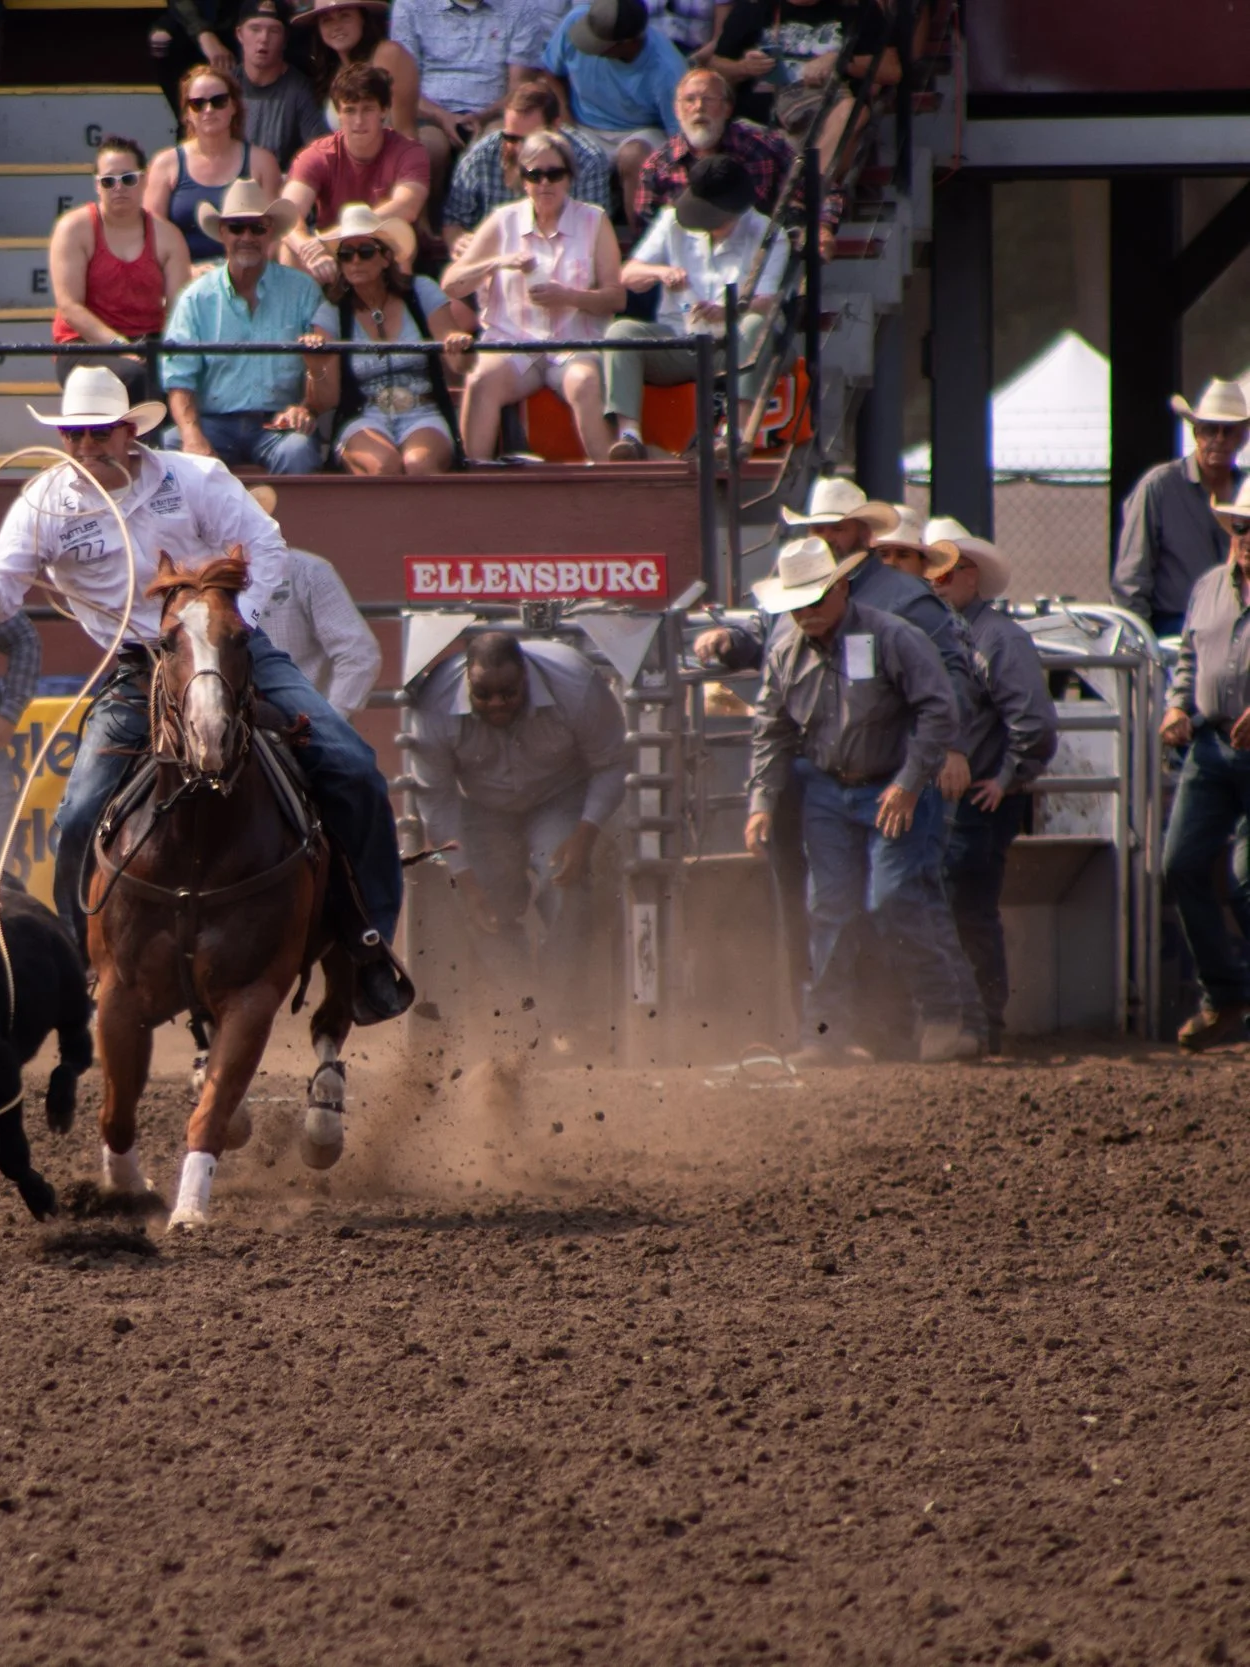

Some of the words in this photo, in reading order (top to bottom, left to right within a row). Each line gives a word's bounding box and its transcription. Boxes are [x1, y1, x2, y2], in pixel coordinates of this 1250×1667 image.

[85, 124, 103, 148] G
[32, 269, 49, 294] E
[412, 561, 661, 594] ELLENSBURG
